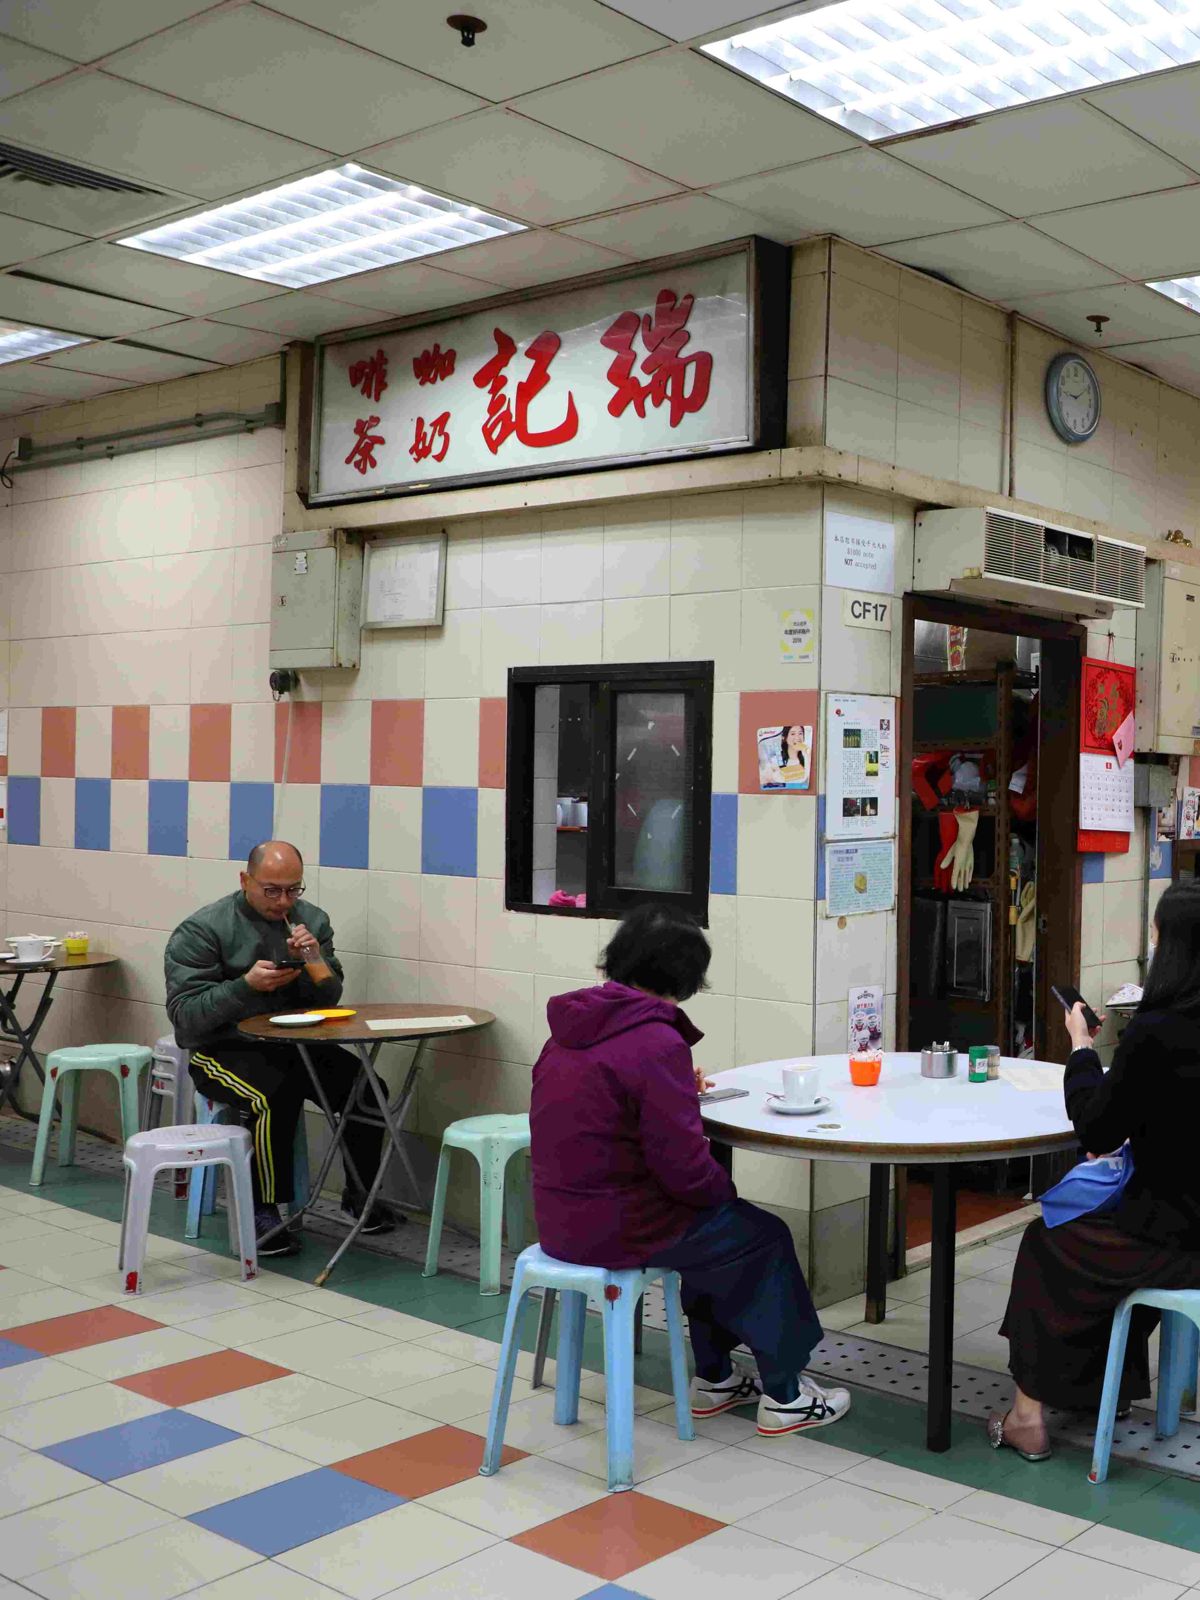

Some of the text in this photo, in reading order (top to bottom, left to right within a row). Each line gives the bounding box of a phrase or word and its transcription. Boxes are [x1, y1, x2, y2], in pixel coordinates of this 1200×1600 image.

[349, 343, 456, 402] 咖啡
[472, 289, 713, 456] 瑞記
[345, 411, 451, 475] 奶茶
[851, 600, 888, 622] CF17
